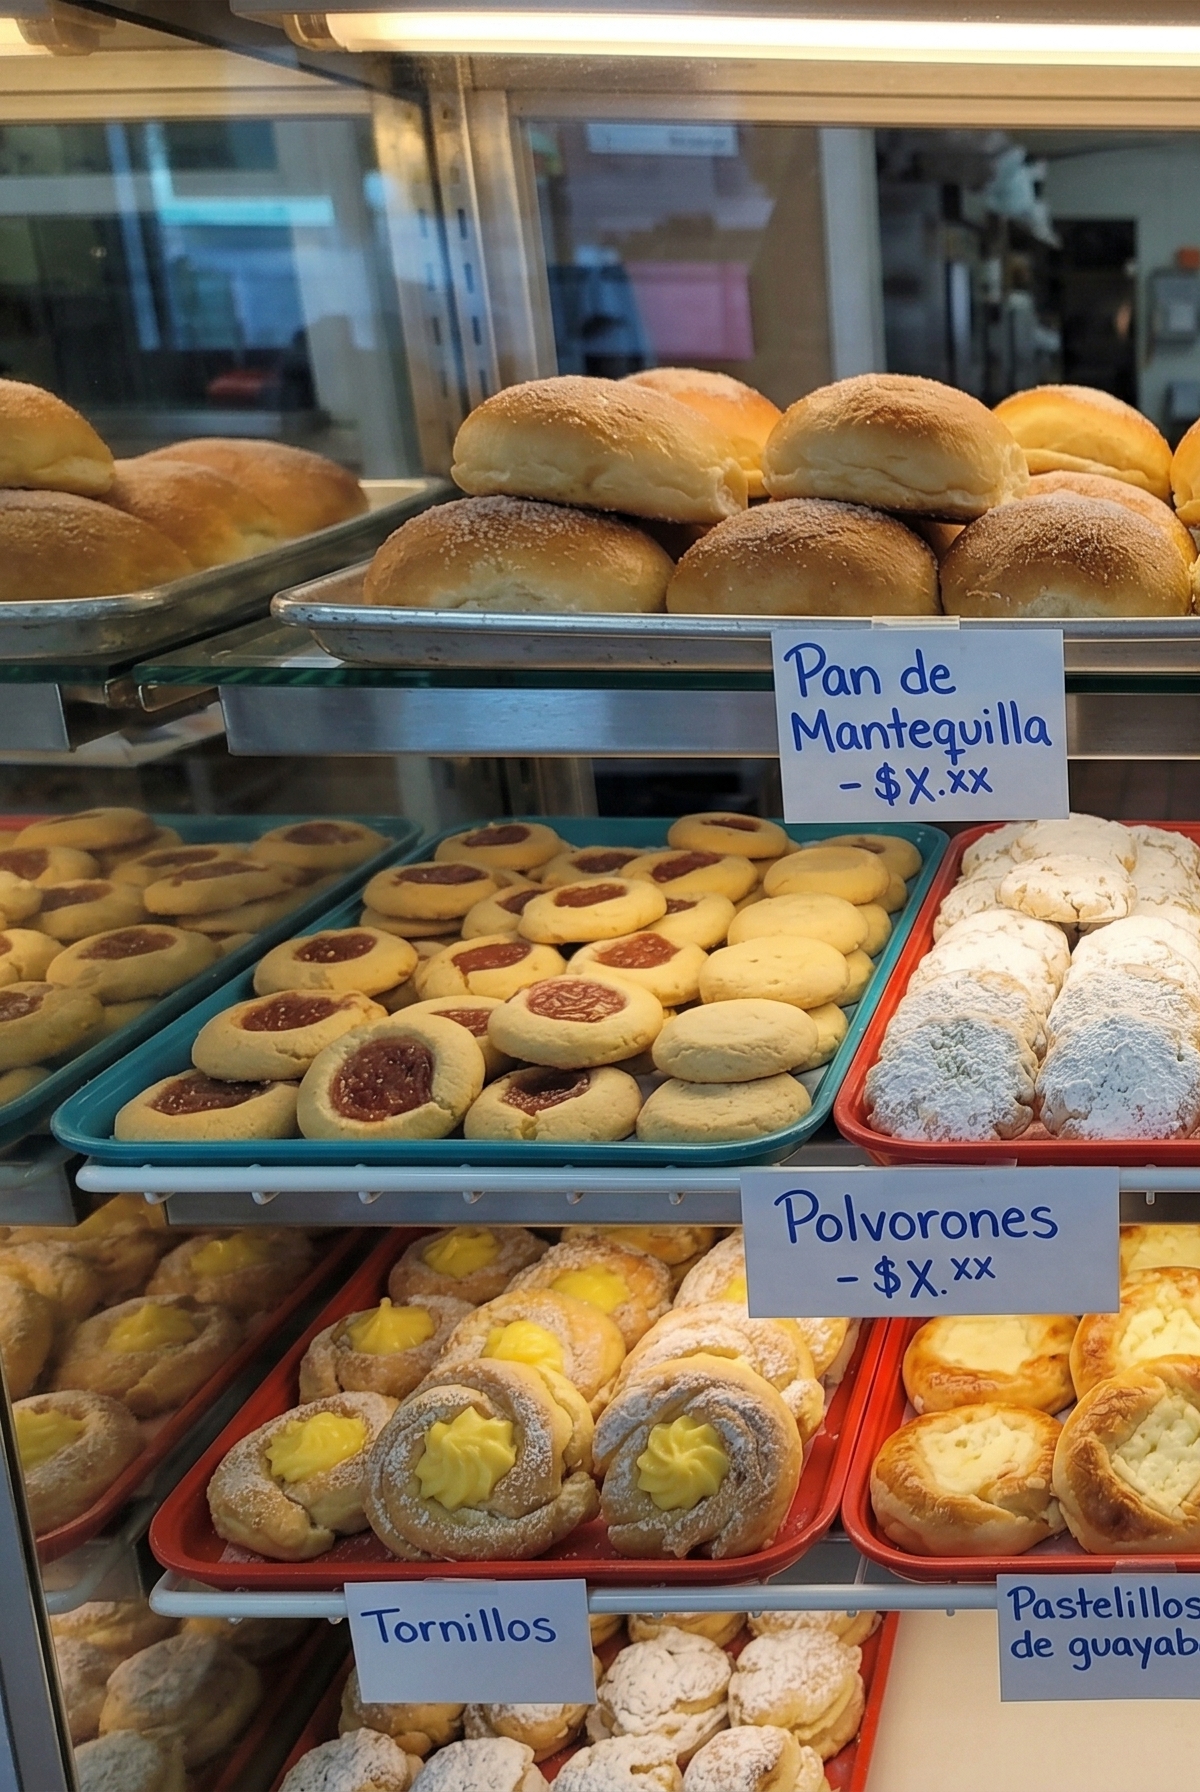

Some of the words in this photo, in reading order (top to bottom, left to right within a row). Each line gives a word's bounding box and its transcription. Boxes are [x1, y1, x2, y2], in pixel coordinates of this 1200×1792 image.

[783, 642, 882, 698] Pan
[900, 648, 957, 695] de
[790, 700, 1053, 766] Mantequilla
[773, 1189, 1059, 1244] Polvorones
[360, 1607, 557, 1644] Tornillos
[1010, 1629, 1054, 1659] de
